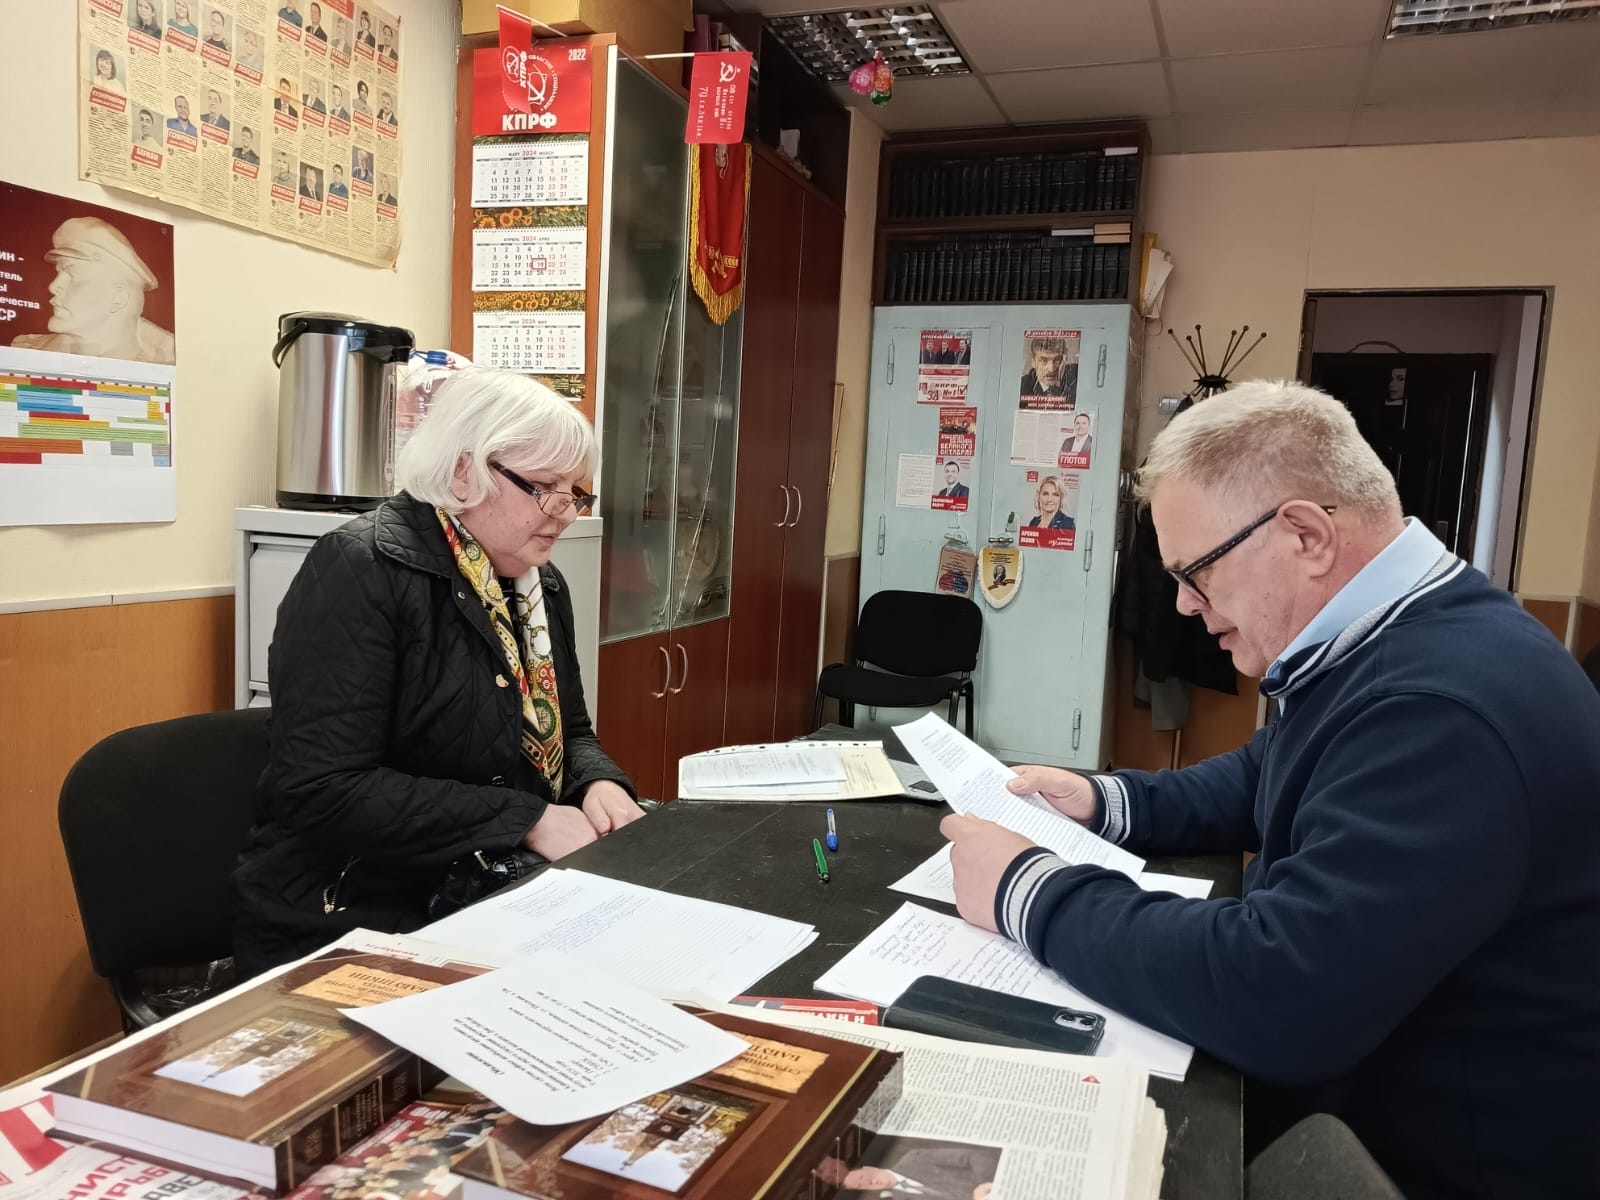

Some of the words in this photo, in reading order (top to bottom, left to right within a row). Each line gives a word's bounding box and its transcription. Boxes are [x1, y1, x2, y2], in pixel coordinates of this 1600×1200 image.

[568, 48, 586, 61] 2022
[520, 51, 528, 88] КПРФ
[502, 112, 558, 131] КПРФ
[1060, 456, 1087, 464] ГЛОТОВ
